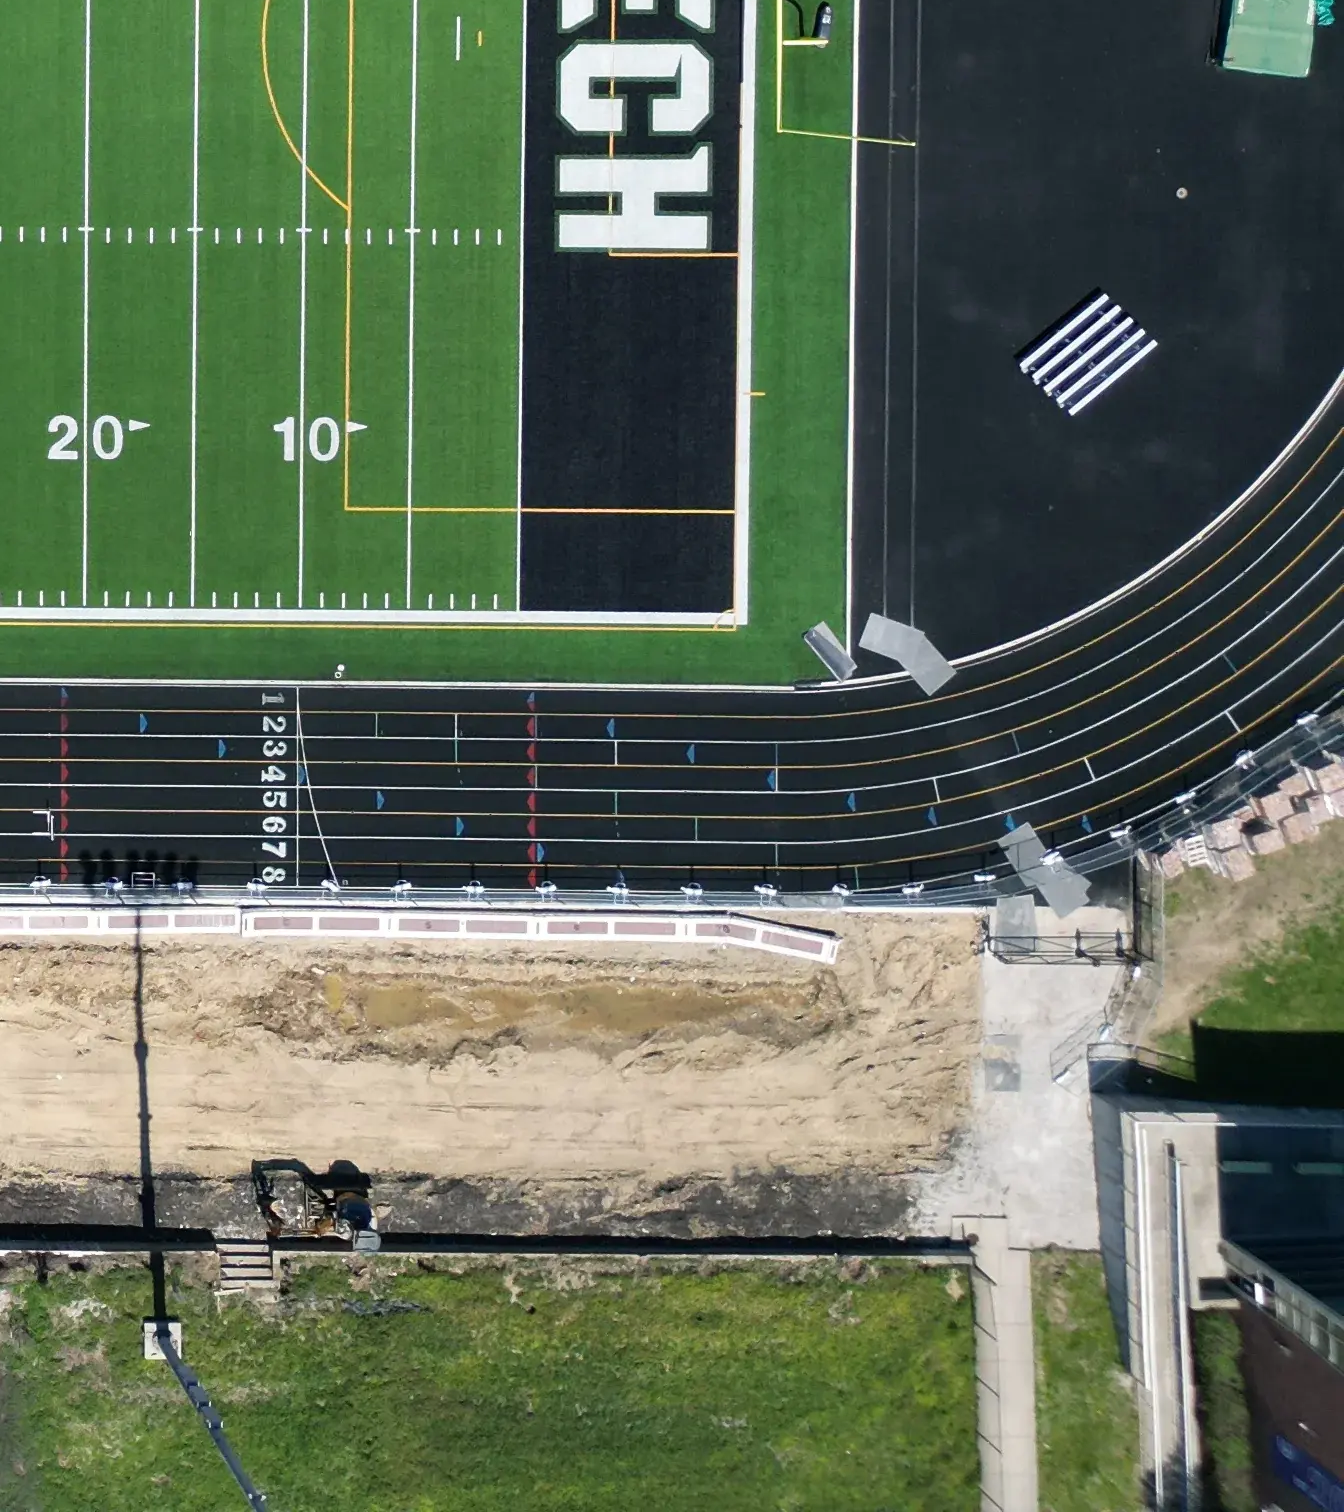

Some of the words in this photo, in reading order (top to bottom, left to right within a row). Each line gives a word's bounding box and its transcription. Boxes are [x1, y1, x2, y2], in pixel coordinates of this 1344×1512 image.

[47, 414, 124, 460] 20
[273, 416, 340, 462] 10
[261, 692, 285, 706] 1
[262, 715, 287, 733] 2
[262, 739, 288, 758] 3
[260, 765, 287, 783] 4
[262, 790, 288, 808] 5
[262, 815, 287, 833] 6
[261, 841, 287, 859] 7
[261, 866, 287, 884] 8
